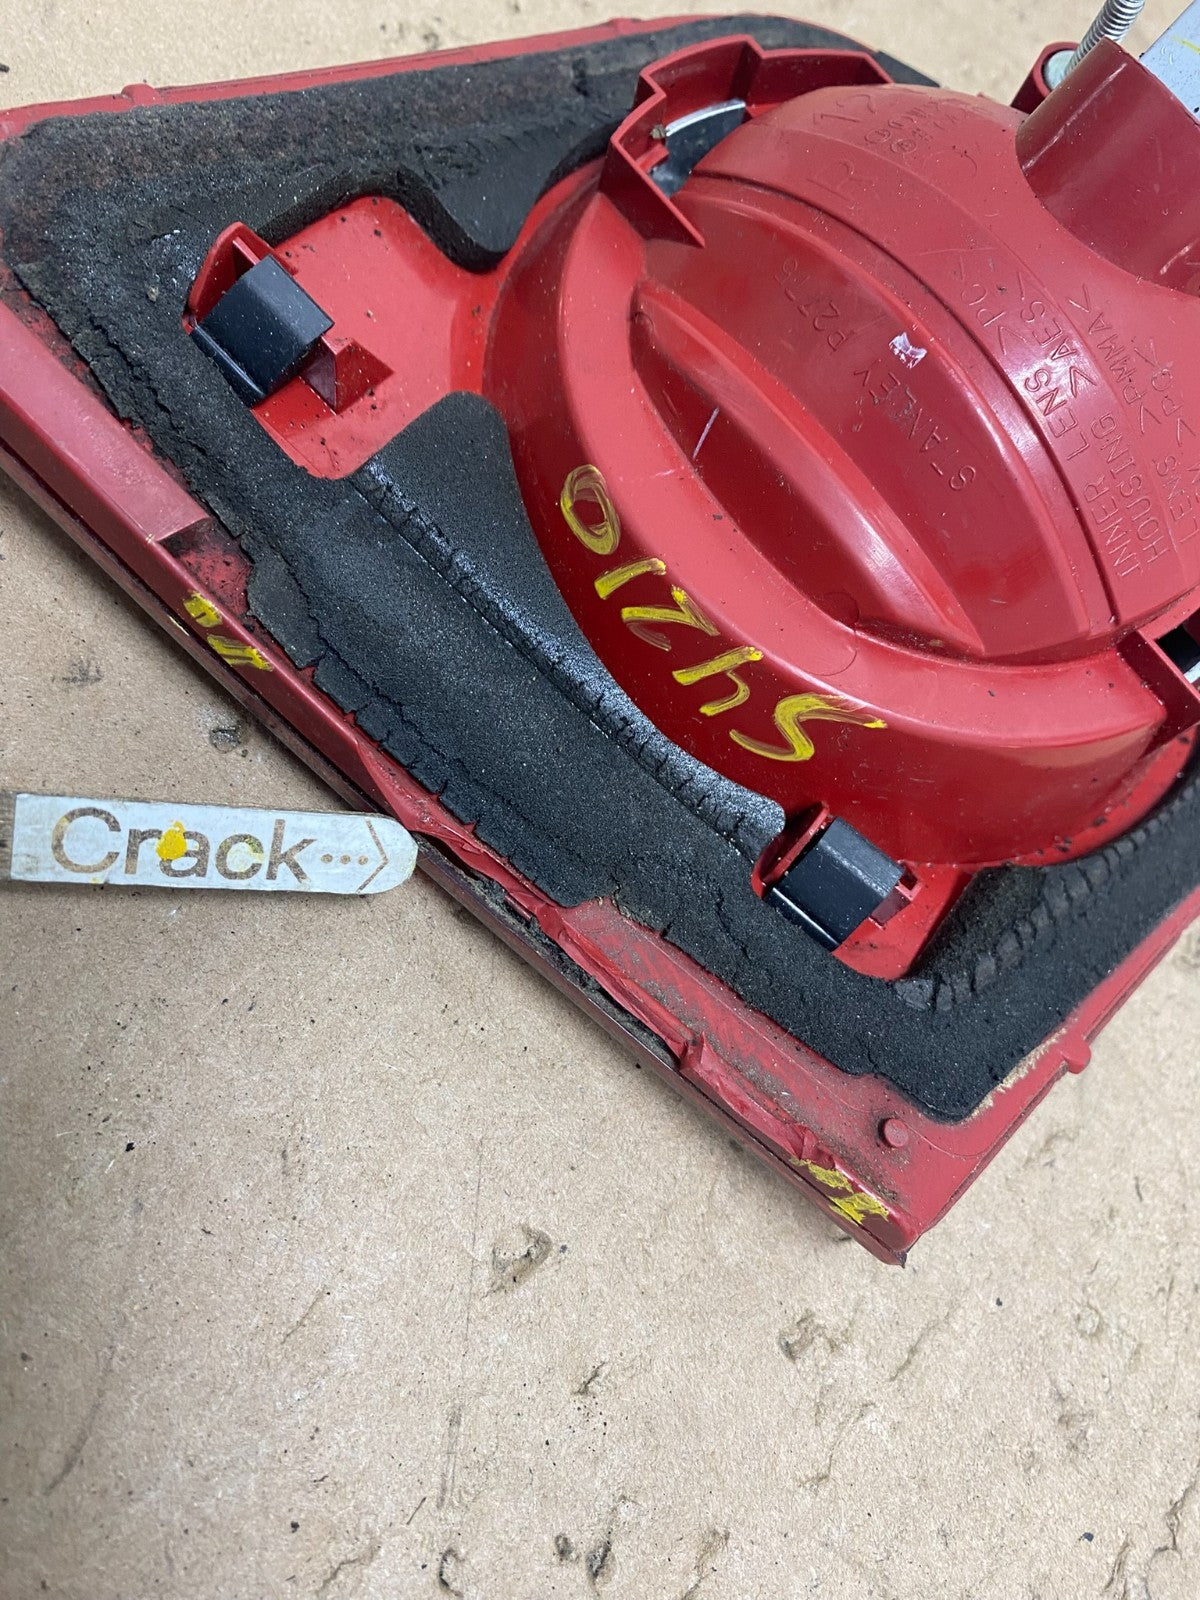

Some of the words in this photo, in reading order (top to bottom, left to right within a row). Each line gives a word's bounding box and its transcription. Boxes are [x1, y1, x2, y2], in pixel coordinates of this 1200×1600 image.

[853, 358, 976, 491] STANLEY
[1024, 367, 1090, 461] LENS
[1083, 473, 1143, 577] INNER
[1090, 411, 1173, 565] HOUSING
[1154, 455, 1200, 543] LENS
